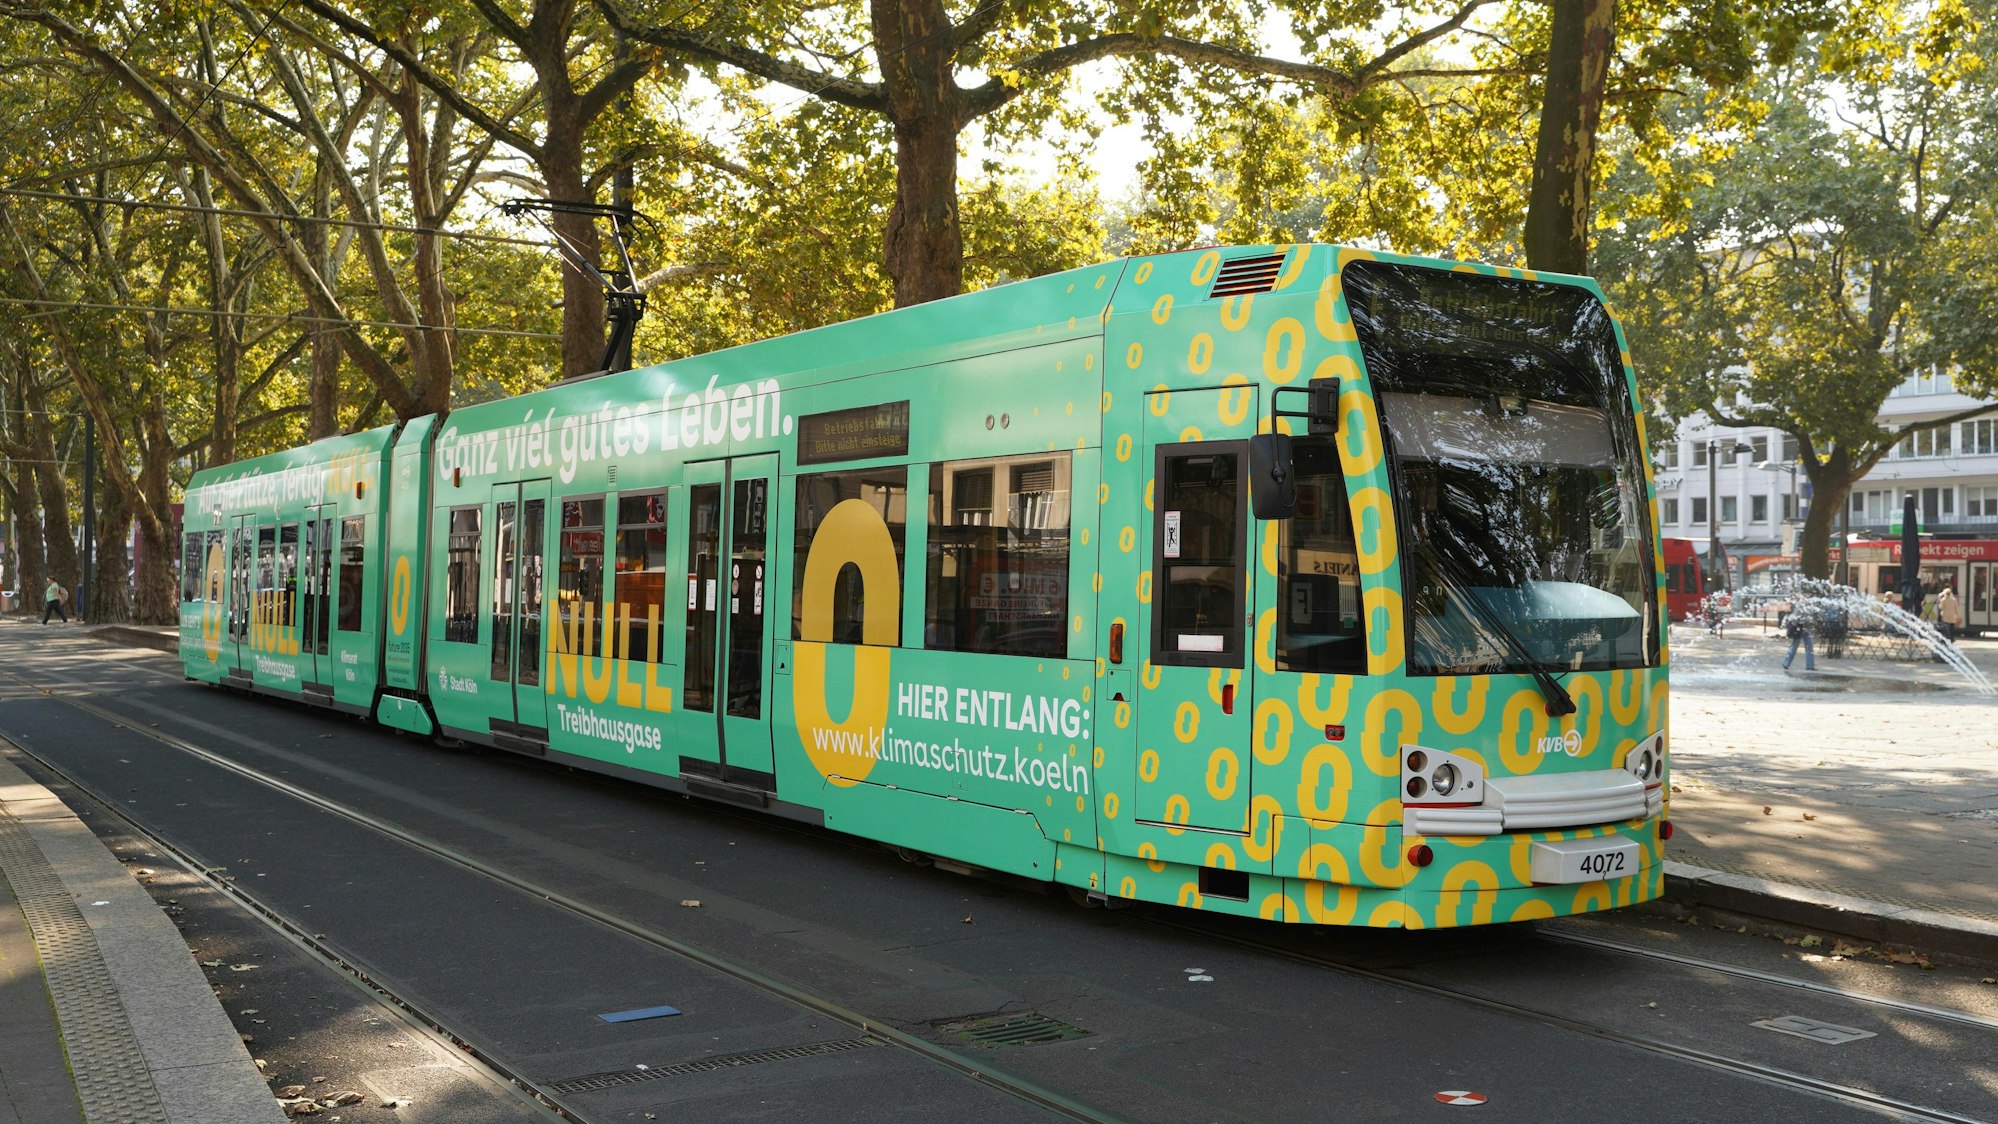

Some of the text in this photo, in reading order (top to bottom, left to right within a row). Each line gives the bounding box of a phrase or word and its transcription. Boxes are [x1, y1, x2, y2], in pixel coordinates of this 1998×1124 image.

[438, 374, 794, 485] Ganz viel gutes Leben.
[1943, 545, 1985, 558] zeigen
[251, 591, 298, 656] NULL
[255, 654, 296, 683] Treibhausgase
[546, 599, 673, 714] NULL
[449, 675, 478, 694] Stadt Köln
[557, 704, 662, 754] Treibhausgase
[897, 682, 1091, 741] HIER ENTLANG:
[812, 726, 1090, 796] www.klimaschutz.koeln
[1536, 736, 1563, 754] KVB
[1580, 852, 1625, 874] 4072
